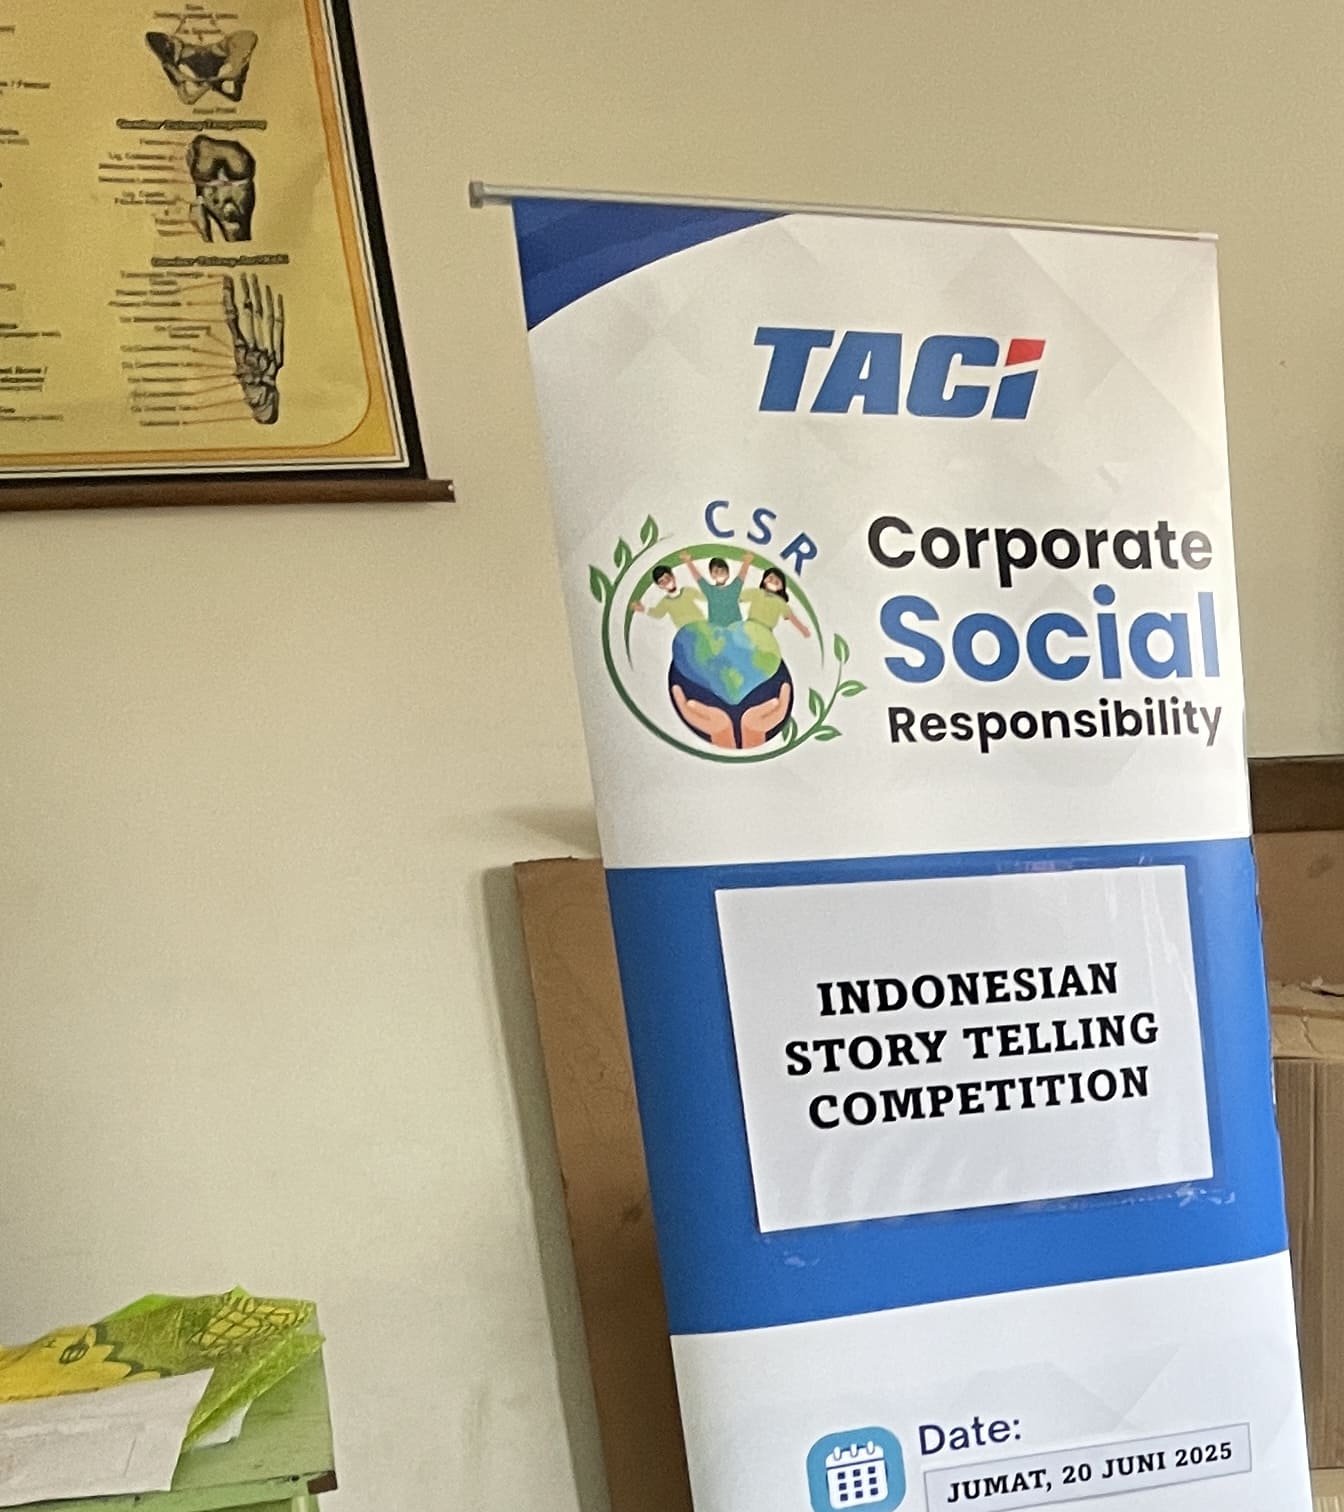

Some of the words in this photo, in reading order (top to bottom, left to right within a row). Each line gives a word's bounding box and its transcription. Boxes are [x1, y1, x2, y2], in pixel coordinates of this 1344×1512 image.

[868, 514, 1213, 588] Corporate
[880, 583, 1221, 686] Social
[889, 699, 1223, 754] Responsibility
[817, 962, 1118, 1016] INDONESIAN
[785, 1030, 947, 1077] STORY
[963, 1012, 1159, 1061] TELLING
[809, 1066, 1149, 1130] COMPETITION
[918, 1416, 1022, 1456] Date:
[947, 1468, 1053, 1504] JUMAT,
[1061, 1462, 1093, 1486] 20
[1101, 1452, 1167, 1480] JUNI
[1174, 1441, 1233, 1468] 2025
